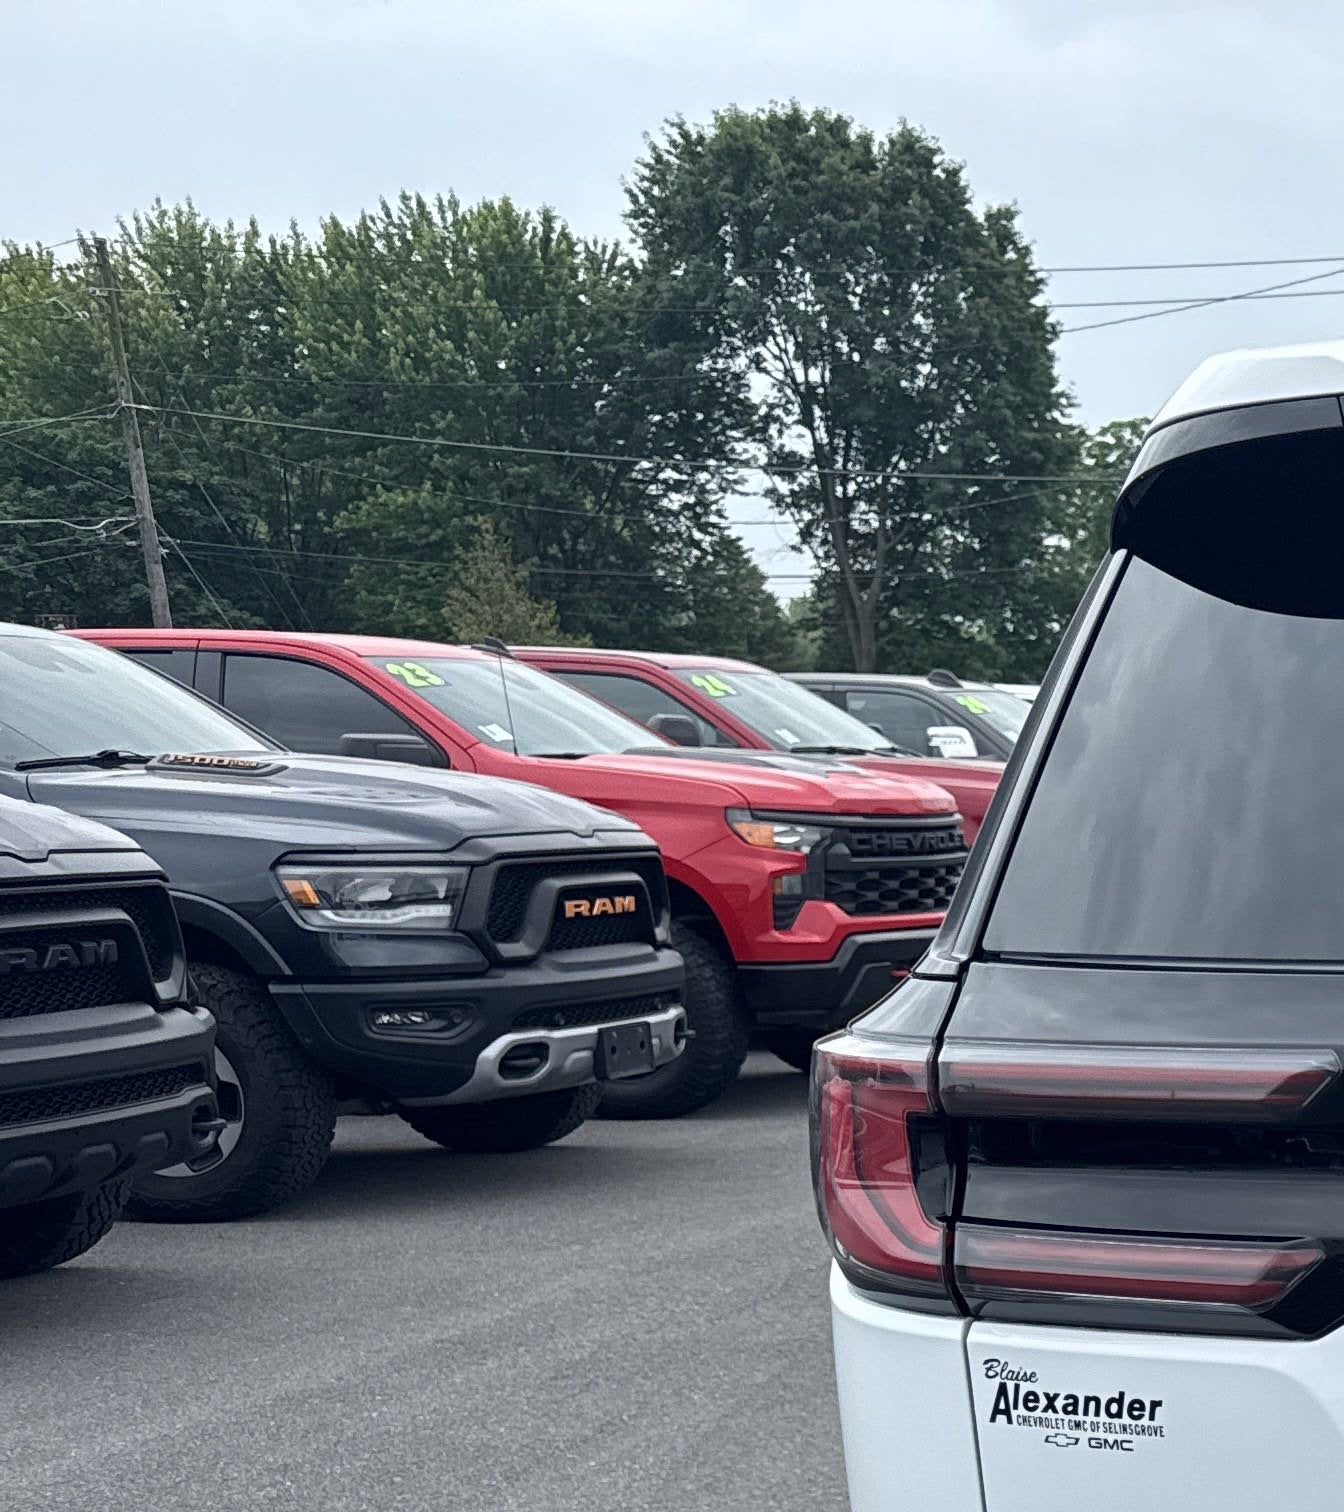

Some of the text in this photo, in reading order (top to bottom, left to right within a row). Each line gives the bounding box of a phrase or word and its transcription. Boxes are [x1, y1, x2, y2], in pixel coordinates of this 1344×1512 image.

[386, 662, 446, 687] 23
[691, 674, 737, 697] 24
[564, 896, 636, 918] RAM
[0, 940, 118, 973] RAM
[983, 1358, 1039, 1384] Blaise
[989, 1382, 1163, 1424] Alexander
[1017, 1414, 1065, 1430] CHEVROLET
[1068, 1419, 1088, 1433] GMC
[1090, 1421, 1101, 1433] OF
[1088, 1437, 1135, 1452] GMC
